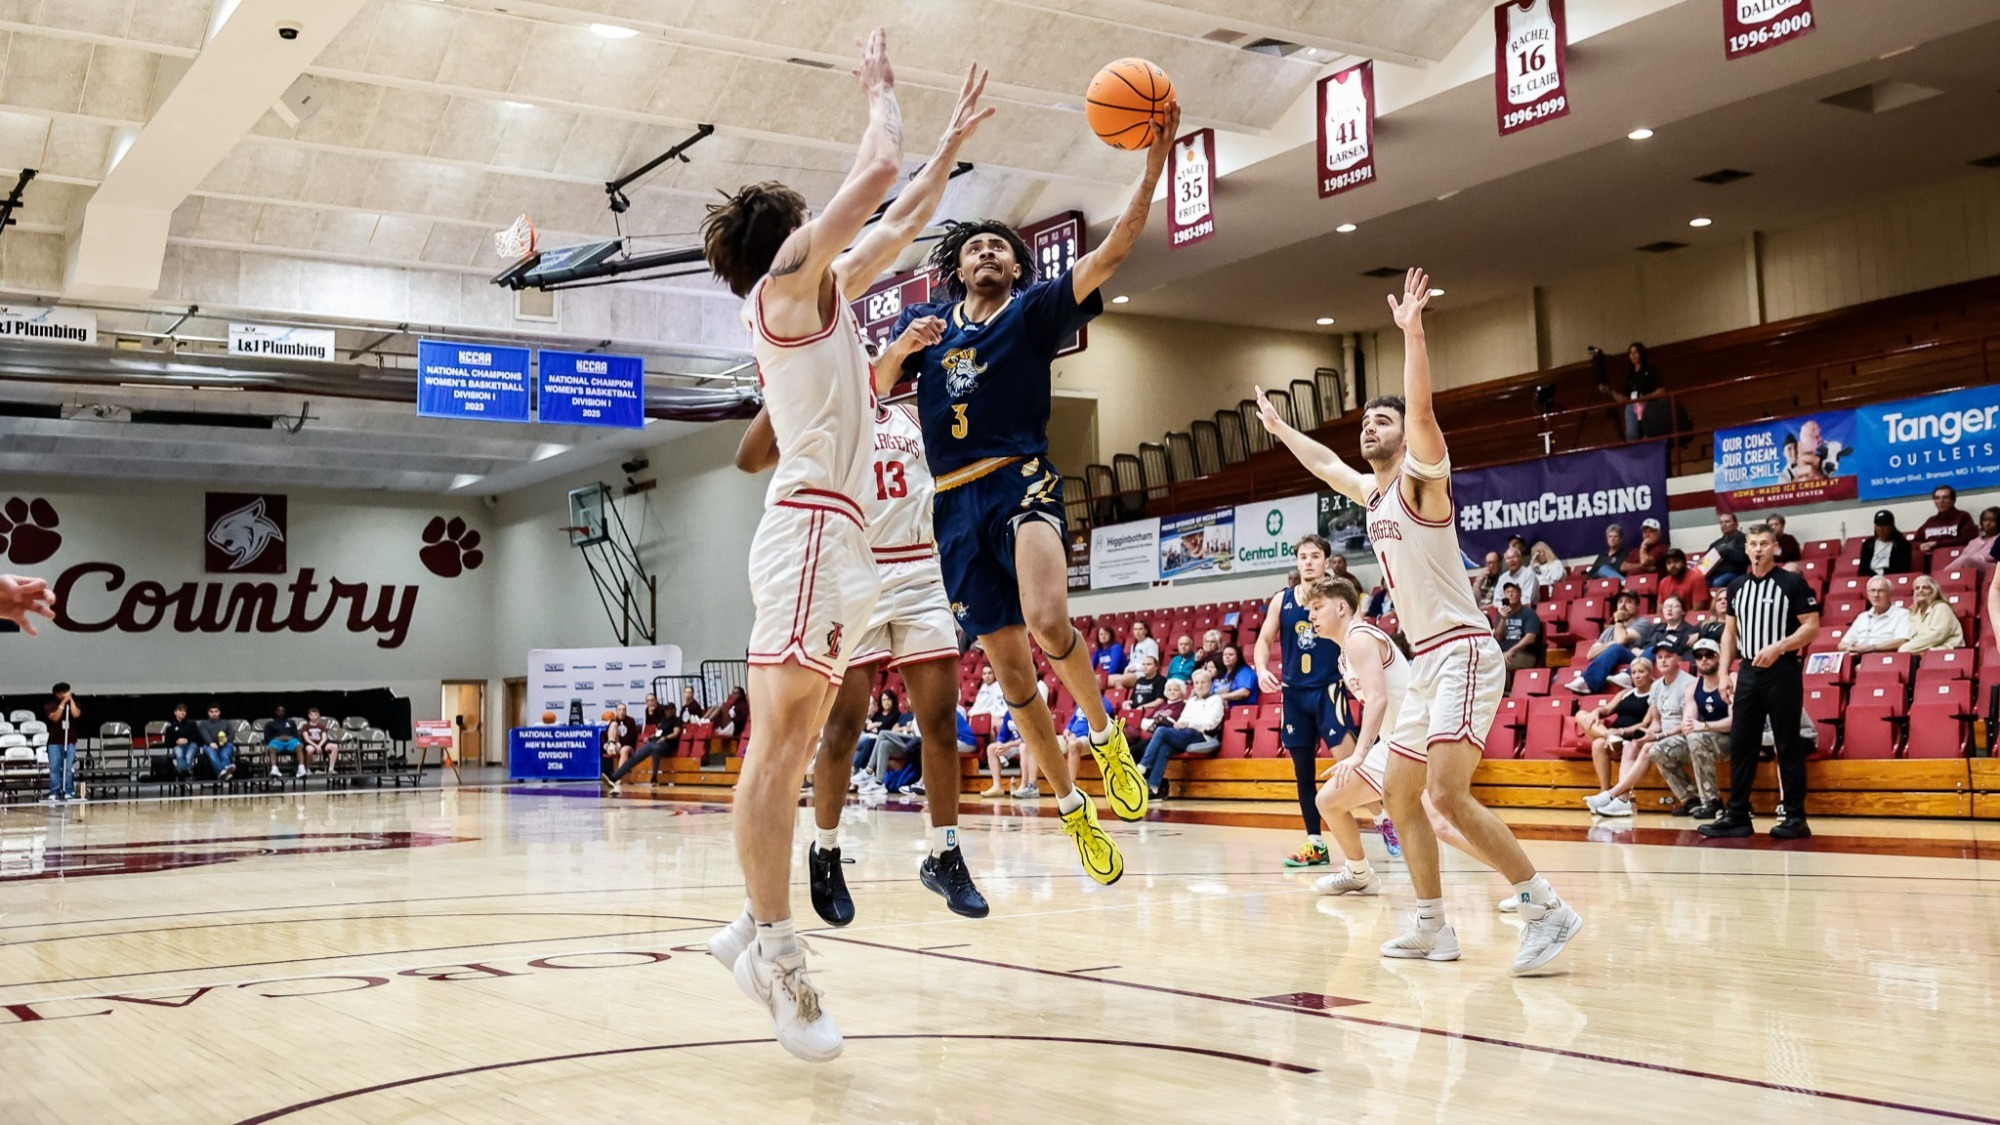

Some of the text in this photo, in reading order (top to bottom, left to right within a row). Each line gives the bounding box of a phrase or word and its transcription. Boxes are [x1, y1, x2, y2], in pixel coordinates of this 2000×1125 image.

[1741, 0, 1797, 19] DALTO
[1511, 28, 1550, 53] RACHEL
[1729, 11, 1811, 52] 1996-2000
[1517, 44, 1546, 76] 16
[1510, 72, 1557, 97] ST. CLAIR
[1503, 96, 1565, 128] 1996-1999
[1336, 119, 1358, 145] 41
[1329, 144, 1366, 165] LARSEN
[1324, 165, 1372, 192] 1987-1991
[1181, 177, 1202, 202] 35
[1179, 202, 1207, 219] FRITTS
[1174, 220, 1213, 244] 1987-1991
[1067, 238, 1075, 255] 3
[15, 321, 87, 341] Plumbing
[238, 339, 325, 358] L&J Plumbing
[458, 351, 492, 366] NCCAA
[576, 360, 607, 374] NCCAA
[427, 366, 523, 380] NATIONAL CHAMPIONS
[548, 375, 634, 388] NATIONAL CHAMPION
[425, 377, 524, 391] WOMEN'S BASKETBALL
[544, 385, 637, 399] WOMEN'S BASKETBALL
[453, 390, 491, 400] DIVISION
[572, 398, 607, 407] DIVISION
[582, 409, 601, 417] 2025
[951, 403, 969, 439] 3
[1882, 405, 1999, 445] Tanger
[1722, 432, 1775, 453] OUR COWS.
[1722, 447, 1780, 468] OUR CREAM.
[1889, 442, 1993, 468] OUTLETS
[873, 461, 908, 500] 13
[1723, 466, 1749, 482] YOUR
[1885, 476, 1906, 485] Tanger
[1733, 478, 1840, 498] HOME-MADE ICE CREAM AT
[1752, 496, 1765, 504] THE
[1796, 489, 1824, 499] CENTER
[1107, 533, 1153, 547] Higginbotham
[1239, 542, 1278, 561] Central
[1381, 551, 1395, 589] 1
[53, 562, 419, 649] Country
[1301, 653, 1312, 674] 0
[519, 730, 593, 739] NATIONAL CHAMPION
[524, 741, 587, 749] MEN'S BASKETBALL
[538, 751, 568, 760] DIVISION
